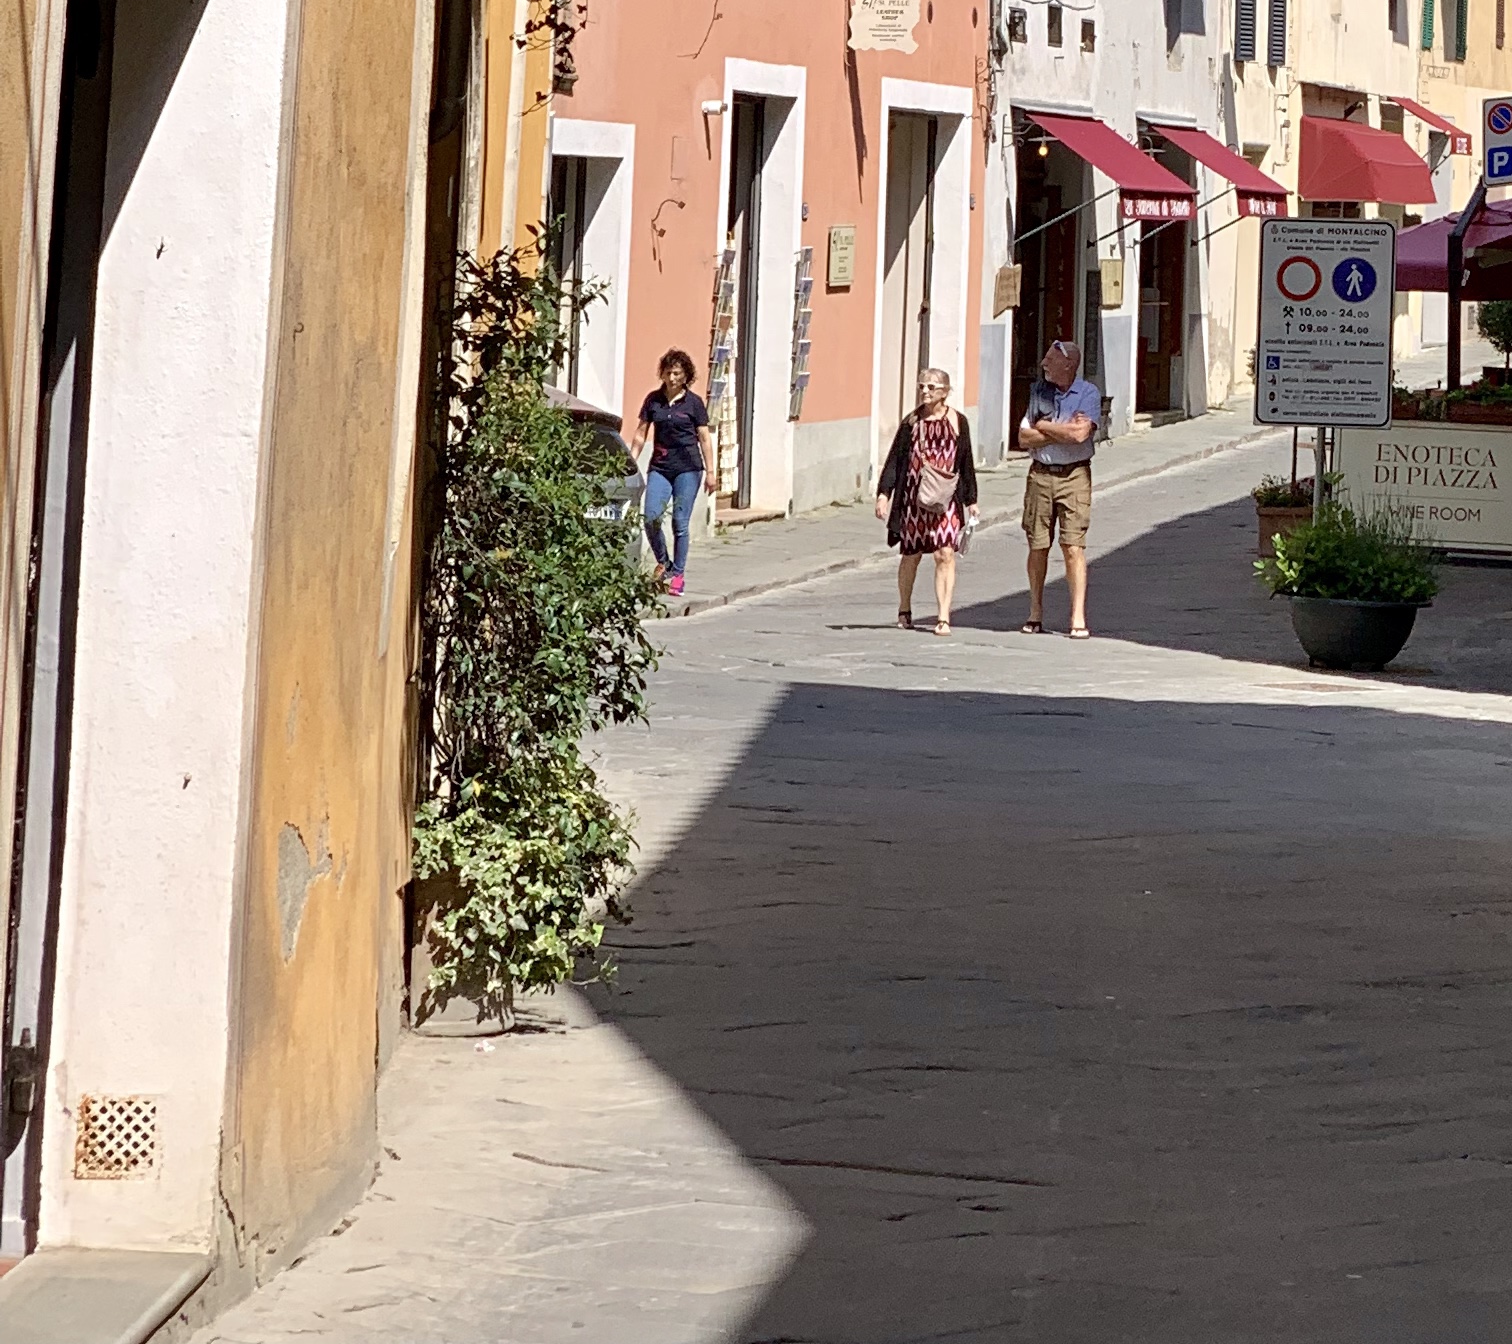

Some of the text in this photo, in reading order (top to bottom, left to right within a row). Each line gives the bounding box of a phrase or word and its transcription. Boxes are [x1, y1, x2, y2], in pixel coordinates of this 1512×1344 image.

[1492, 151, 1509, 175] P
[1281, 226, 1314, 235] Comune
[1327, 228, 1388, 236] MONTALCINO
[1375, 443, 1498, 468] ENOTECA
[1373, 464, 1499, 490] DI PIAZZA
[1390, 504, 1482, 522] WINE ROOM
